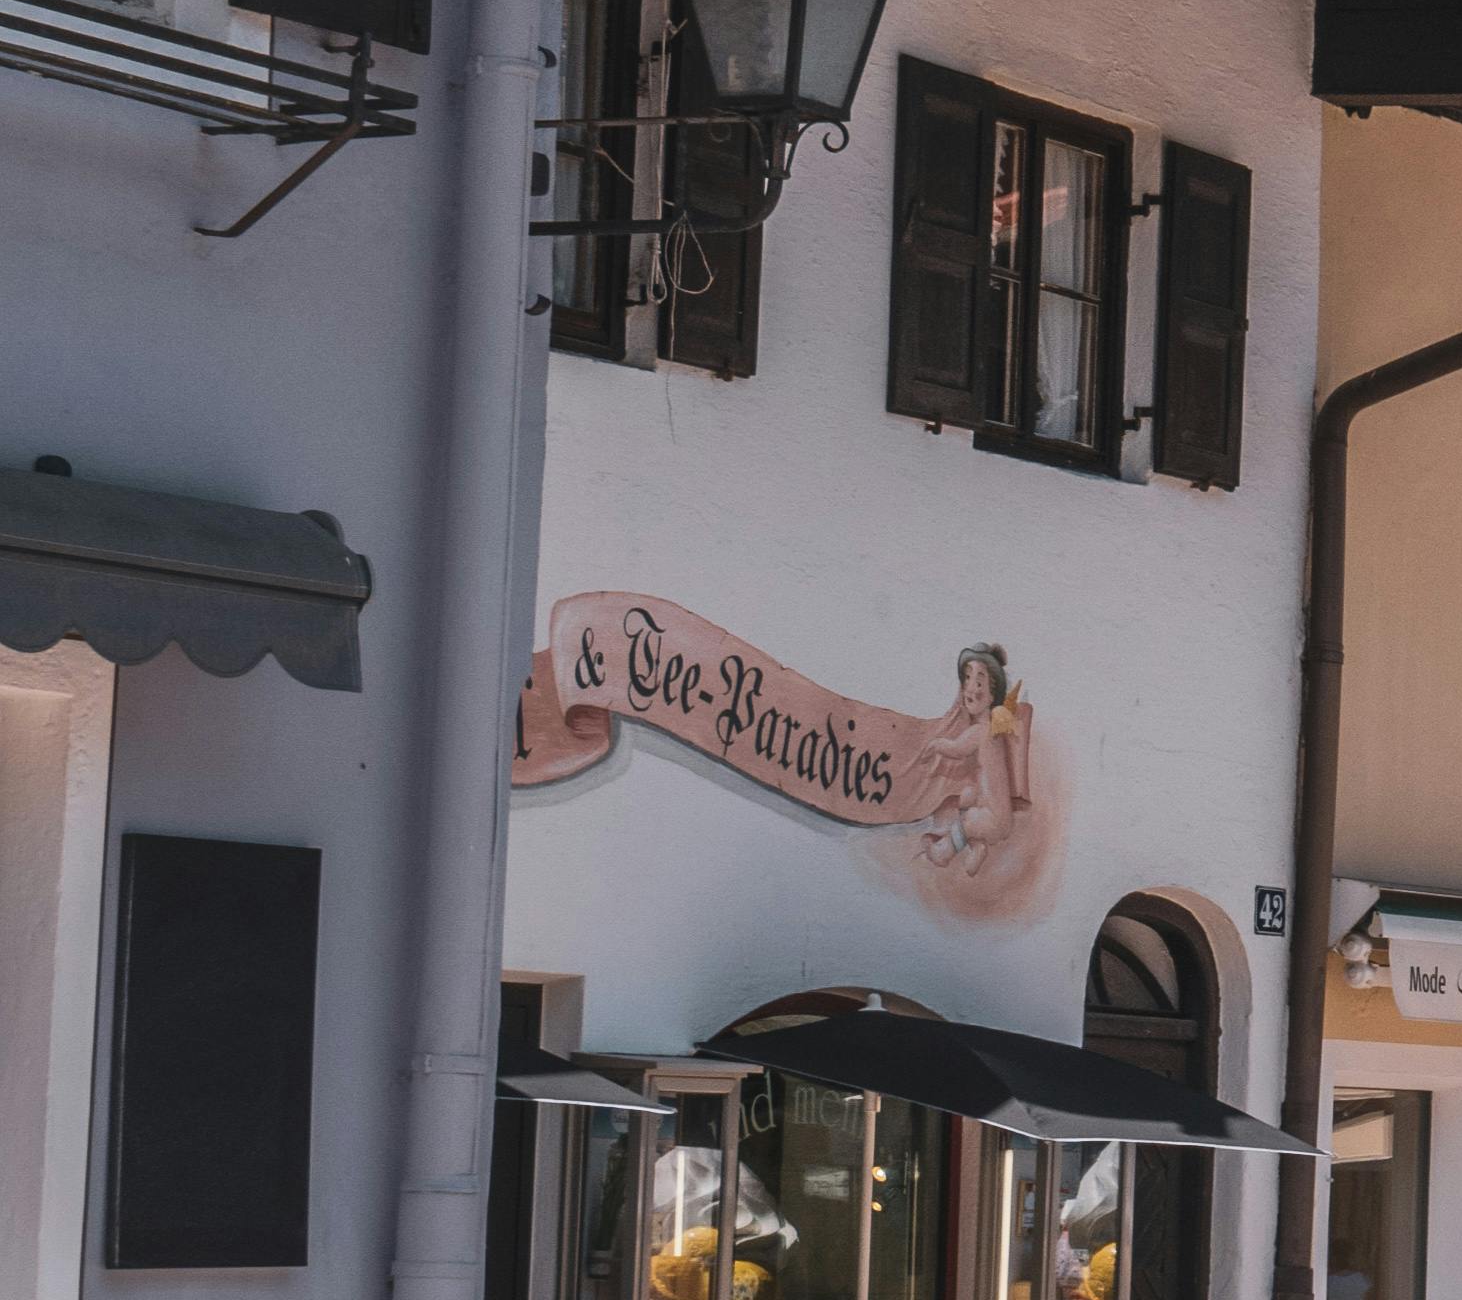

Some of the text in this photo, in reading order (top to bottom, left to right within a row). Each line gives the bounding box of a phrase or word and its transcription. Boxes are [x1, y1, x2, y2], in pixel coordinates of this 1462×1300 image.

[574, 627, 606, 690] &
[623, 607, 893, 806] Tee-Paradies
[1259, 893, 1284, 929] 42
[1409, 965, 1447, 995] Mode
